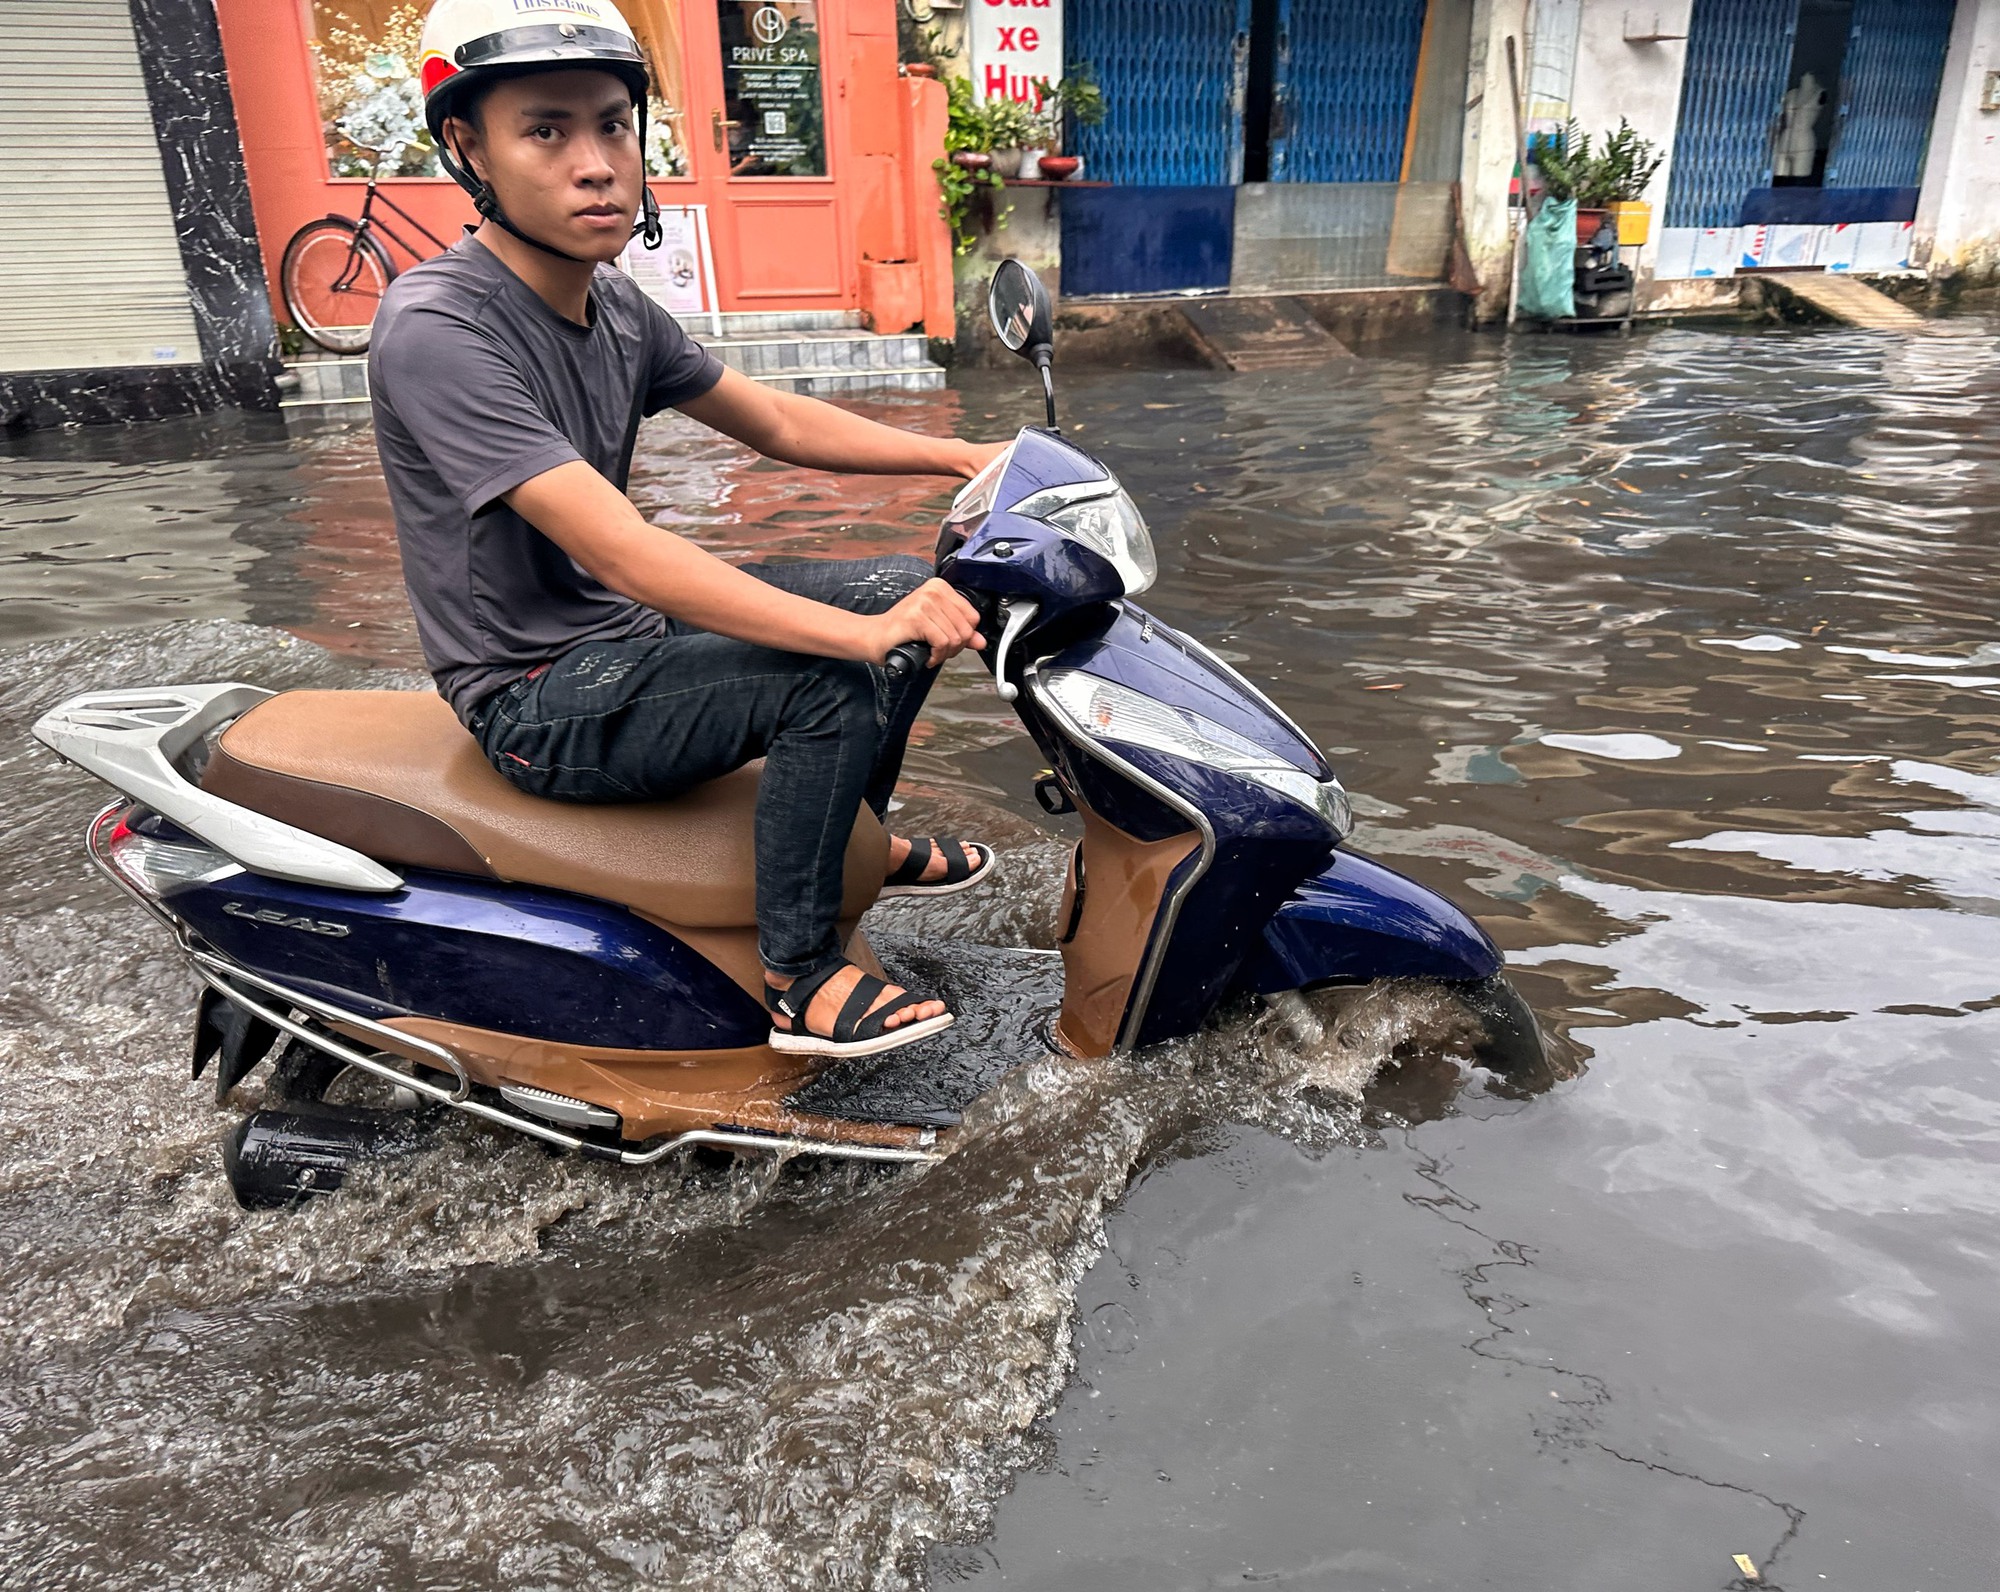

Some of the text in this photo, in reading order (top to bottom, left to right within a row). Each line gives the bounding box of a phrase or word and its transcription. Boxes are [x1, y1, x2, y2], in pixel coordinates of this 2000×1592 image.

[732, 44, 808, 62] PRIVÉ SPA
[997, 27, 1040, 52] xe
[985, 64, 1049, 113] Huy
[222, 902, 350, 938] LEAD
